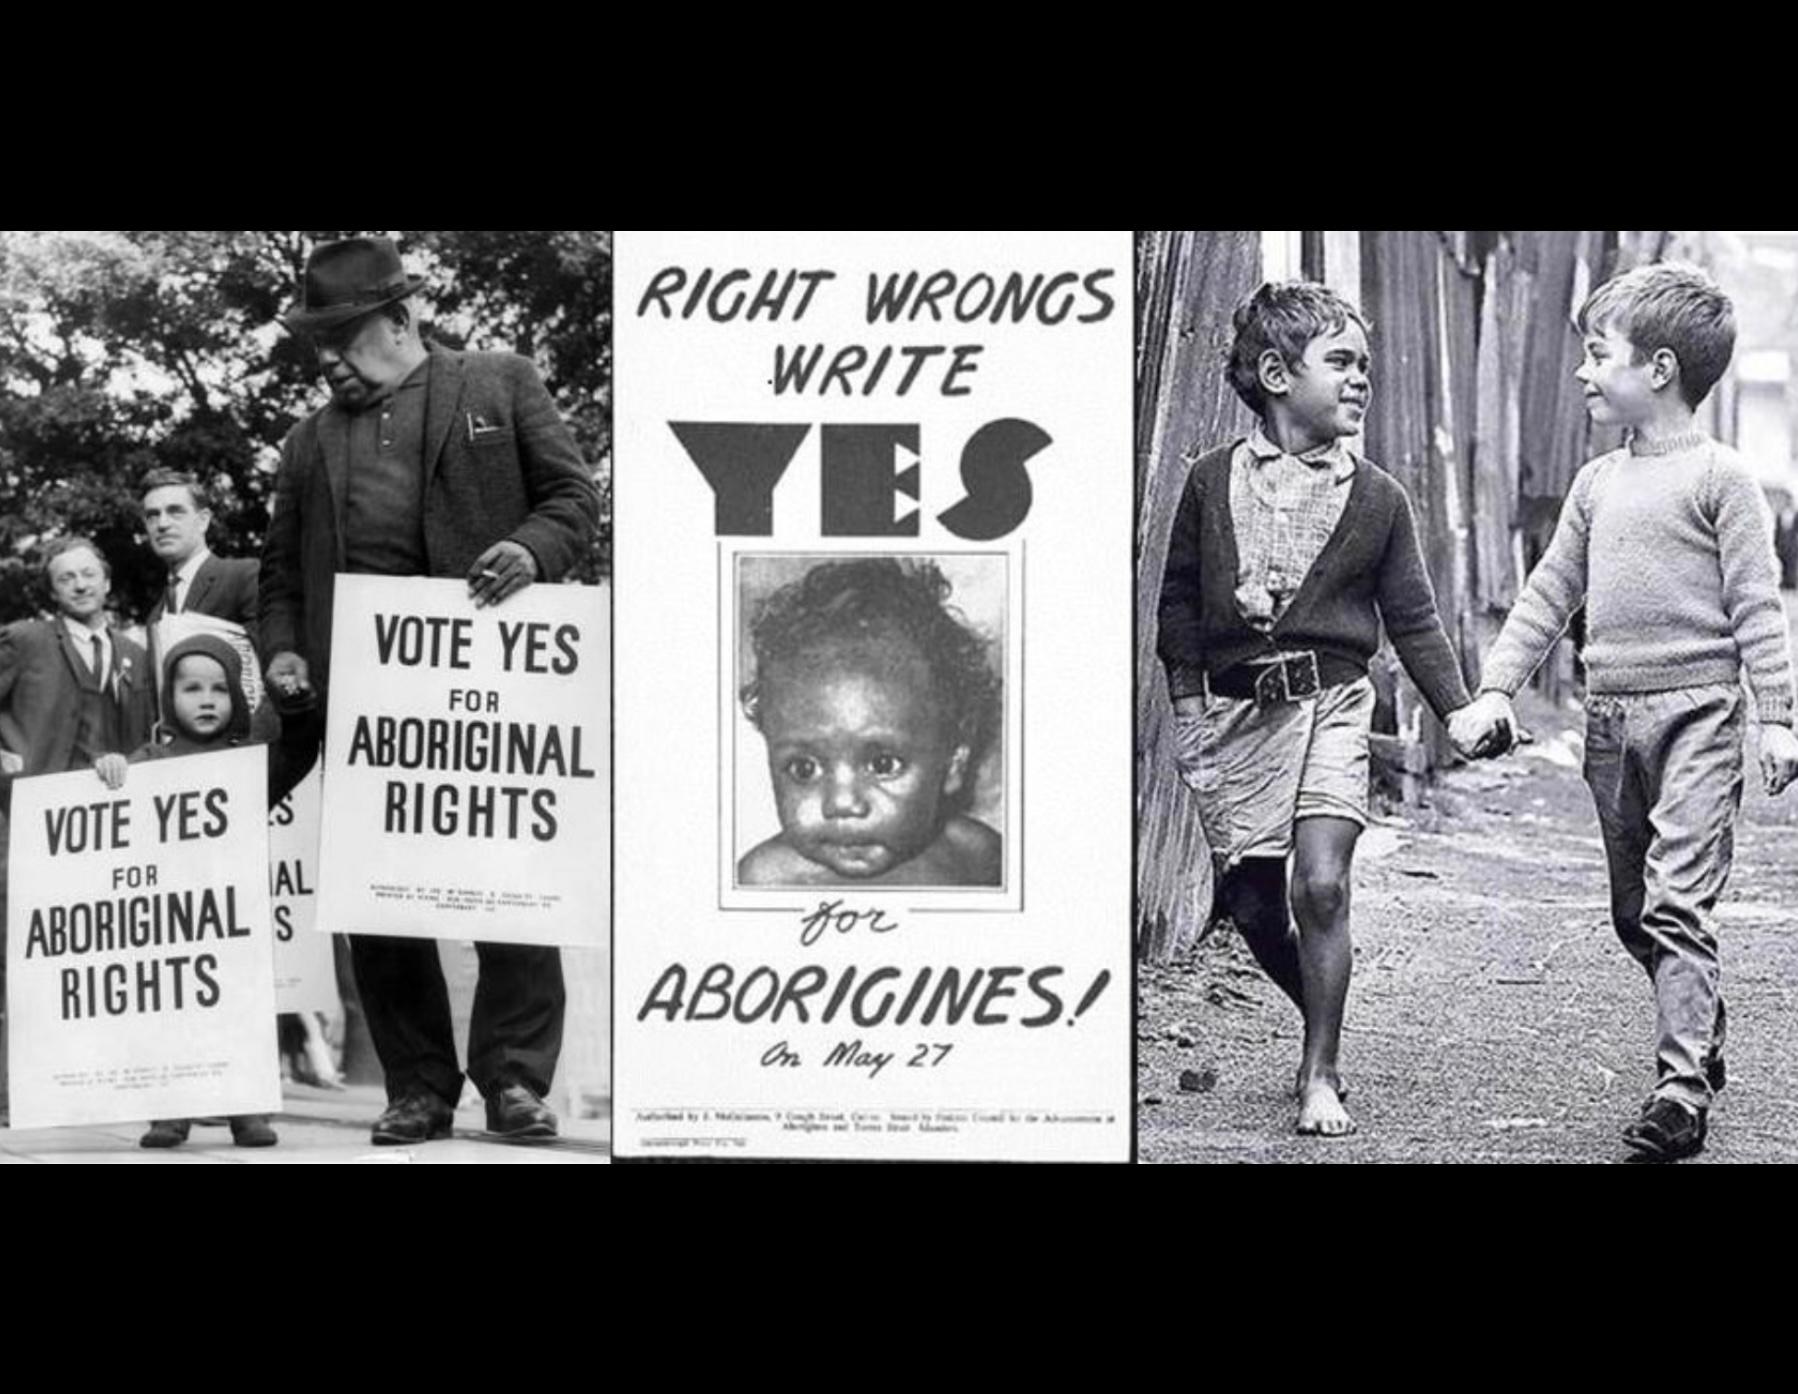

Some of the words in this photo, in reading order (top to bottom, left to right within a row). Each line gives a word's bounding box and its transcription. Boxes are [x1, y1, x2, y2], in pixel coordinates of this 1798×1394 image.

[637, 266, 836, 323] RIGHT
[866, 269, 1115, 326] WRONGS
[774, 343, 984, 396] WRITE
[666, 417, 1053, 541] YES
[374, 613, 473, 670] VOTE
[498, 620, 580, 676] YES
[449, 689, 500, 713] FOR
[347, 715, 595, 779] ABORIGINAL
[45, 799, 131, 856] VOTE
[153, 788, 228, 843] YES
[384, 780, 558, 842] RIGHTS
[112, 865, 157, 890] FOR
[25, 885, 251, 959] ABORIGINAL
[800, 900, 898, 946] for
[61, 953, 220, 1020] RIGHTS
[637, 963, 1111, 1028] ABORIGINES!
[761, 1041, 801, 1067] On
[823, 1040, 894, 1078] May
[908, 1043, 953, 1067] 27
